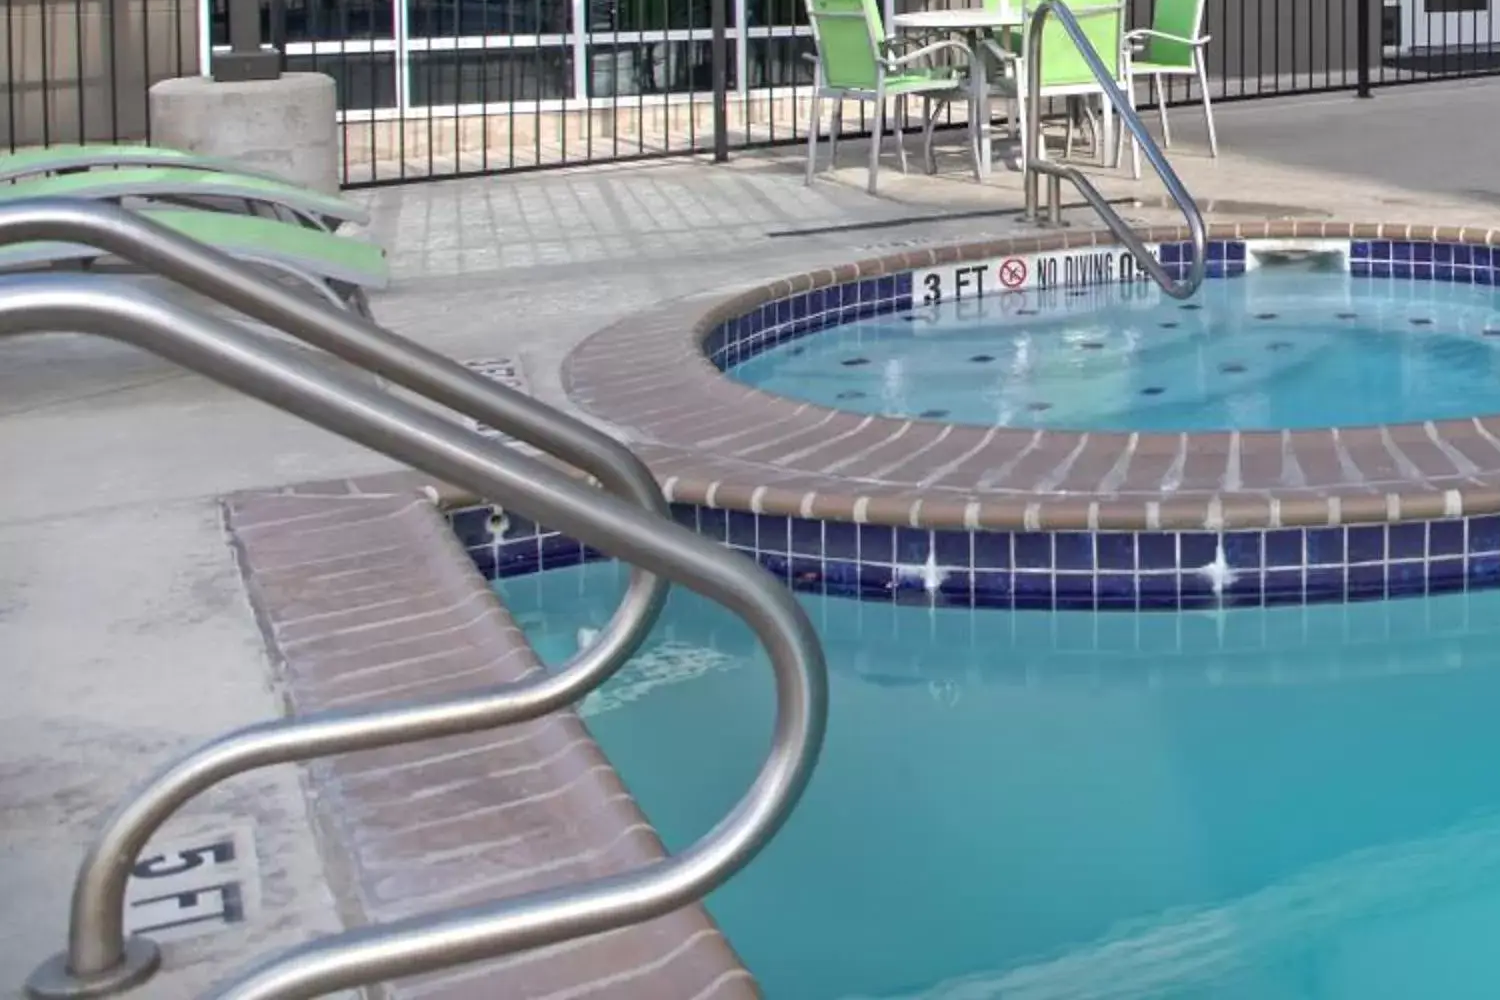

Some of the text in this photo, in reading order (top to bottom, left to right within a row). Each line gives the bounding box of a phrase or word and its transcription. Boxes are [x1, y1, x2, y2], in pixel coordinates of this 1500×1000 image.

[923, 273, 942, 305] 3
[955, 265, 989, 301] FT
[1037, 257, 1057, 290] NO
[1064, 250, 1114, 287] DIVING
[130, 840, 245, 935] 5 FT
